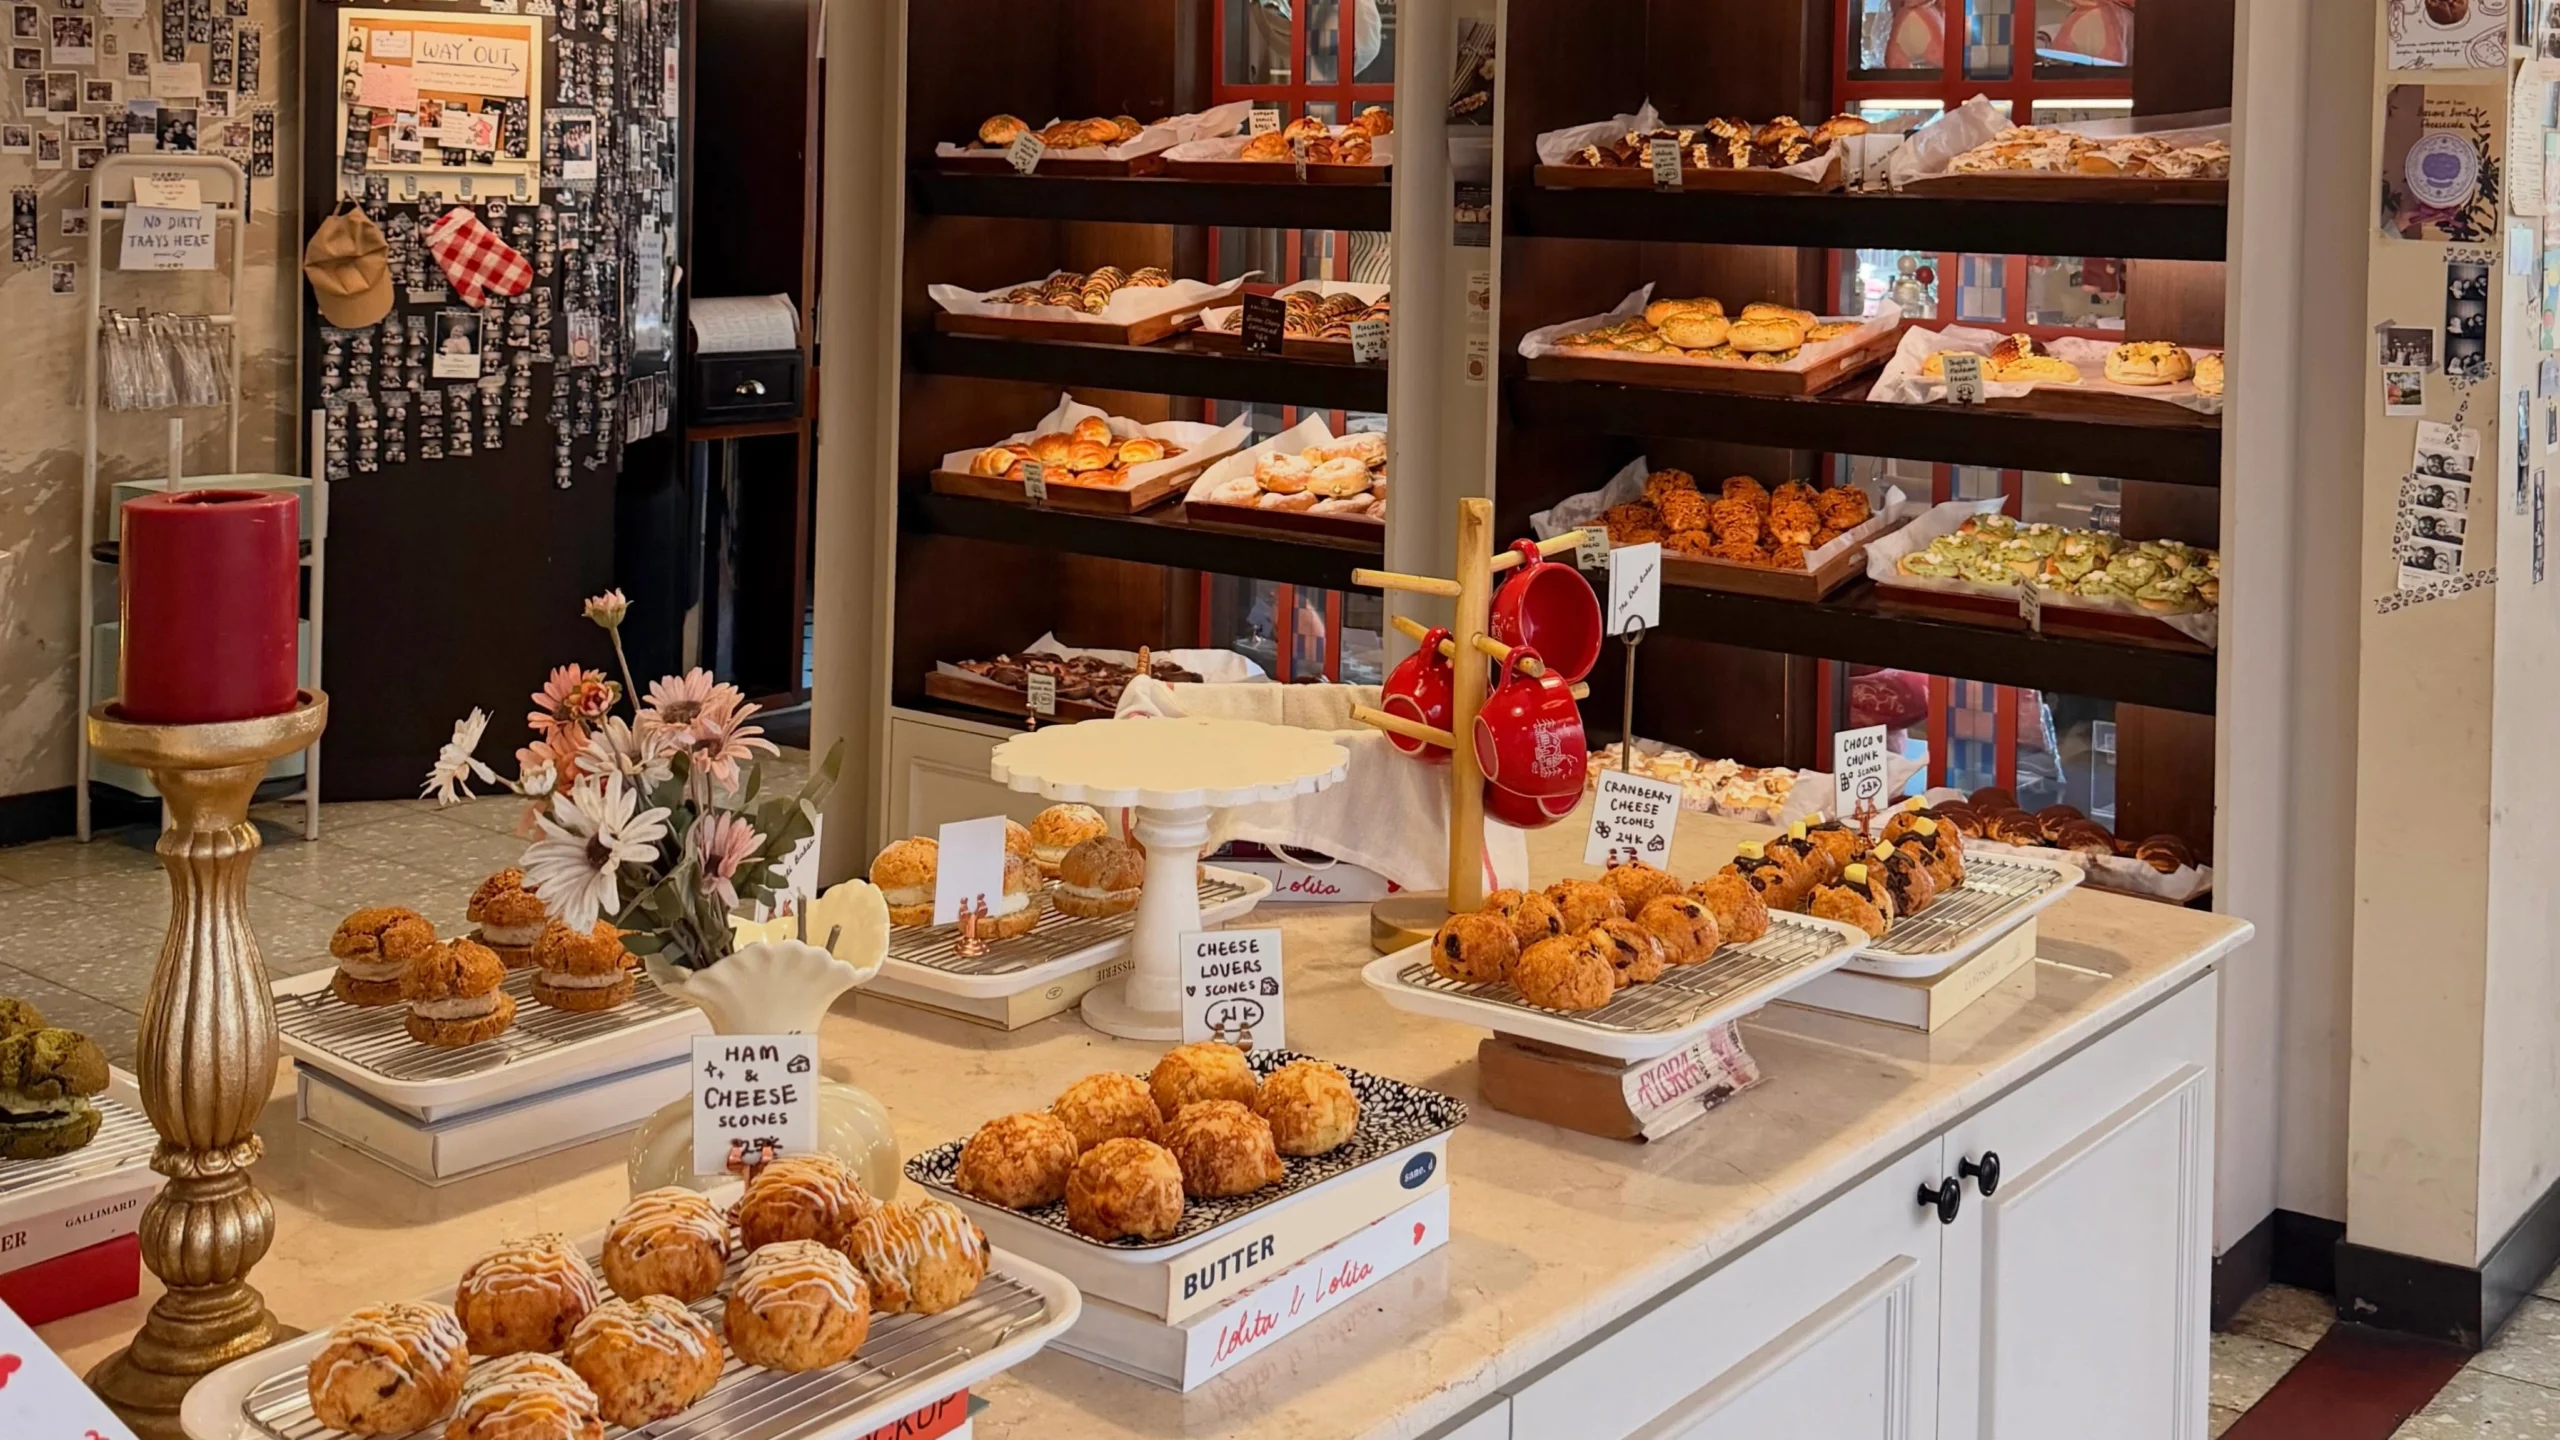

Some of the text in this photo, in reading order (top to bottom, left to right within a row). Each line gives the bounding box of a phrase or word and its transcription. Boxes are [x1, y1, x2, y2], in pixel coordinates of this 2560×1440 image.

[423, 41, 463, 61] WAY
[473, 46, 511, 64] OUT
[143, 215, 202, 230] NO DIRTY
[128, 234, 210, 248] TRAYS HERE
[1844, 736, 1873, 752] CHOCO
[1846, 750, 1879, 767] CHUNK
[1857, 764, 1882, 778] SCONES
[1604, 780, 1672, 804] CRANBERRY
[1610, 798, 1660, 815] CHEESE
[1614, 816, 1655, 829] SCONES
[1275, 869, 1341, 895] Lolita
[1197, 939, 1260, 957] CHEESE
[1096, 959, 1136, 982] TISSERIE
[1201, 959, 1262, 979] LOVERS
[1205, 980, 1256, 997] SCONES
[725, 1045, 780, 1062] HAM
[744, 1069, 759, 1082] &
[704, 1084, 798, 1109] CHEESE
[718, 1112, 788, 1128] SCONES
[65, 1199, 137, 1228] GALLIMARD
[1183, 1234, 1275, 1300] BUTTER
[1315, 1258, 1374, 1303] Lolita
